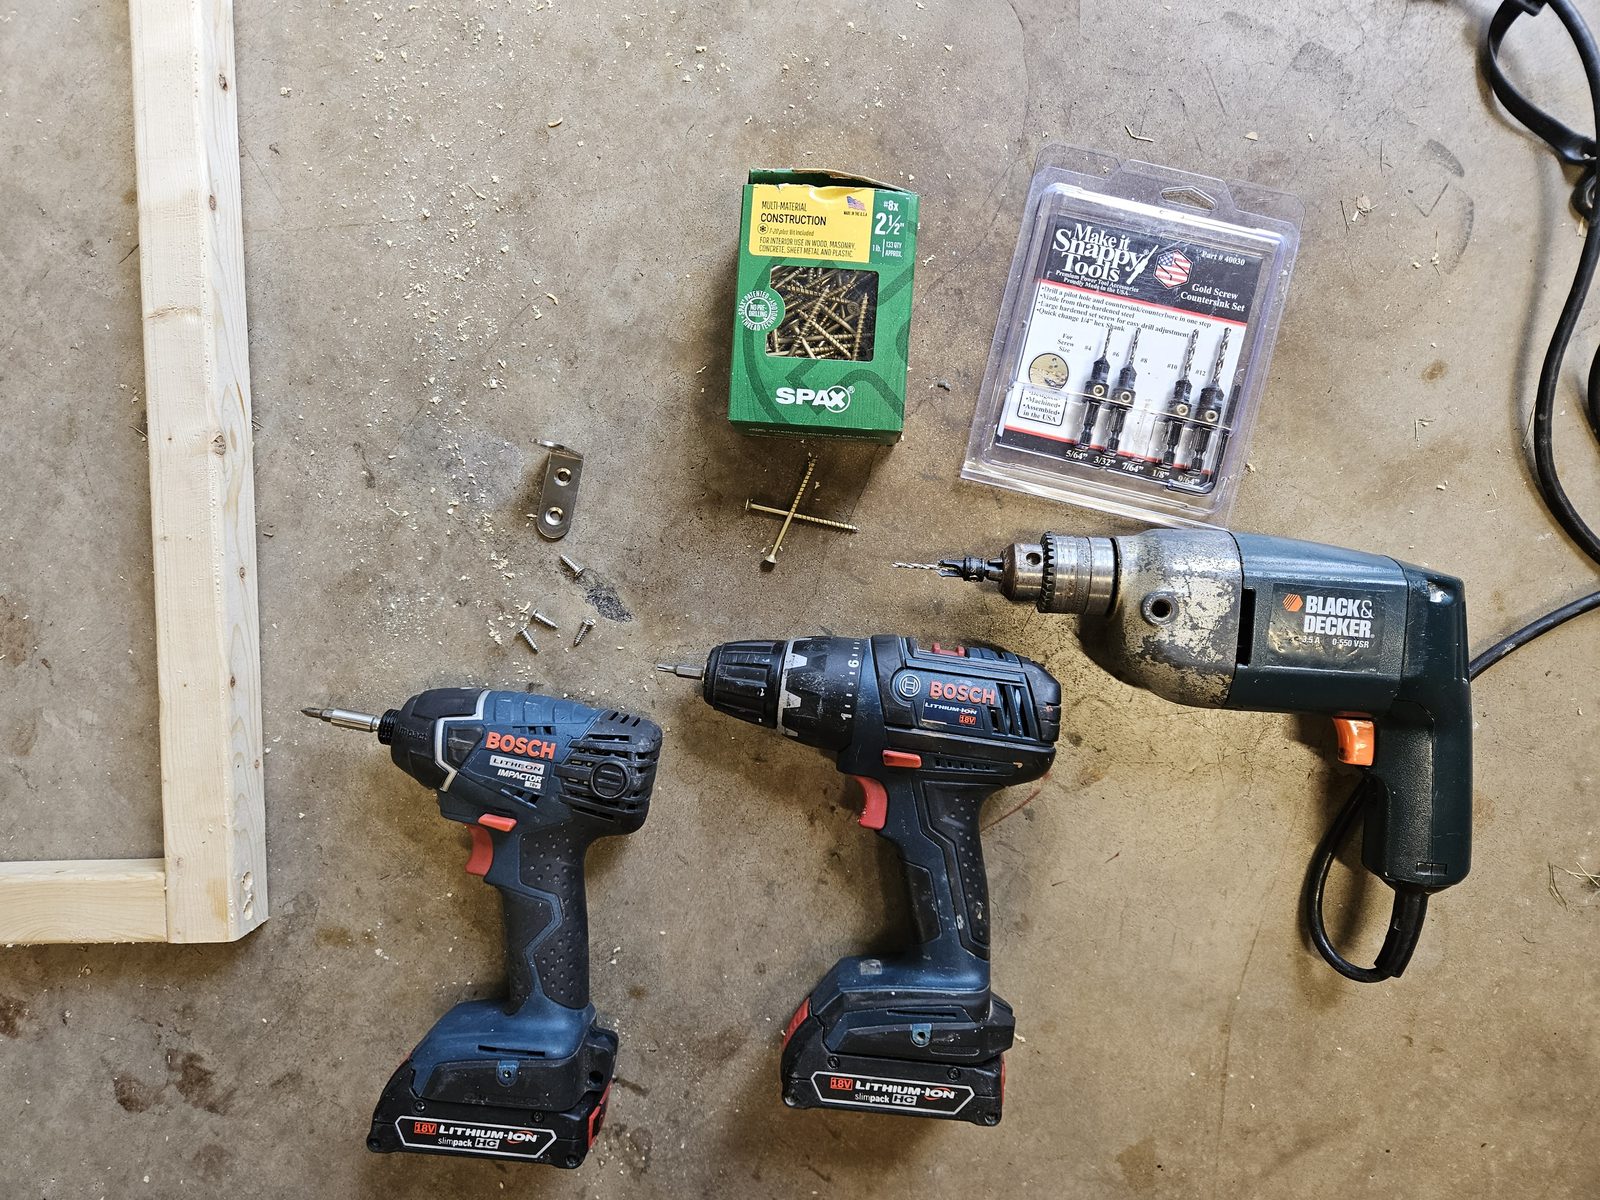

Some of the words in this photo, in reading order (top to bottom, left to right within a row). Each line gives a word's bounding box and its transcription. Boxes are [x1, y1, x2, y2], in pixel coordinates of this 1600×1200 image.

[762, 200, 807, 212] MULTI-MATERIAL
[760, 213, 826, 226] CONSTRUCTION
[771, 237, 793, 245] INTERIOR
[805, 239, 810, 247] IN
[1074, 223, 1117, 248] Make
[1119, 235, 1131, 251] it
[787, 246, 802, 254] SHEET
[1052, 228, 1146, 272] Snappy
[1201, 250, 1217, 260] Part
[1224, 257, 1245, 266] 40030
[1060, 252, 1120, 282] Tools
[1056, 270, 1080, 280] Premium
[1081, 275, 1097, 283] Power
[1063, 277, 1084, 287] Proudly
[1192, 283, 1212, 294] Gold
[1213, 287, 1239, 300] Screw
[1060, 297, 1075, 307] from
[1076, 300, 1120, 315] thru-hardened
[1121, 311, 1135, 319] steel
[1180, 291, 1231, 309] Countersink
[1232, 302, 1246, 312] Set
[1063, 291, 1078, 300] pilot
[1079, 293, 1092, 301] hole
[1092, 297, 1104, 305] and
[1199, 319, 1212, 328] step
[1039, 308, 1056, 317] Quick
[1058, 313, 1079, 322] change
[1106, 322, 1125, 332] Shank
[1060, 304, 1088, 316] hardened
[1127, 320, 1139, 328] easy
[1141, 322, 1154, 331] drill
[1155, 326, 1190, 338] adjustment
[1057, 339, 1074, 347] Screw
[1025, 404, 1058, 415] Assembled
[1042, 414, 1056, 422] USA
[1314, 636, 1320, 644] A
[1332, 638, 1352, 647] 0-550
[1354, 640, 1370, 649] VSR
[929, 680, 996, 705] BOSCH
[924, 702, 978, 715] LITHIUM-ION
[960, 715, 976, 725] 18V
[485, 732, 556, 760] BOSCH
[493, 758, 541, 771] LITHEON
[497, 769, 543, 782] IMPACTOR
[831, 1077, 852, 1090] 18V
[855, 1080, 955, 1099] LITHIUM-ION
[854, 1092, 890, 1104] slimpack
[893, 1095, 917, 1105] HC
[415, 1122, 436, 1134] 18V
[439, 1124, 538, 1143] LITHIUM-ION
[437, 1137, 472, 1148] slimpack
[476, 1139, 499, 1149] HC
